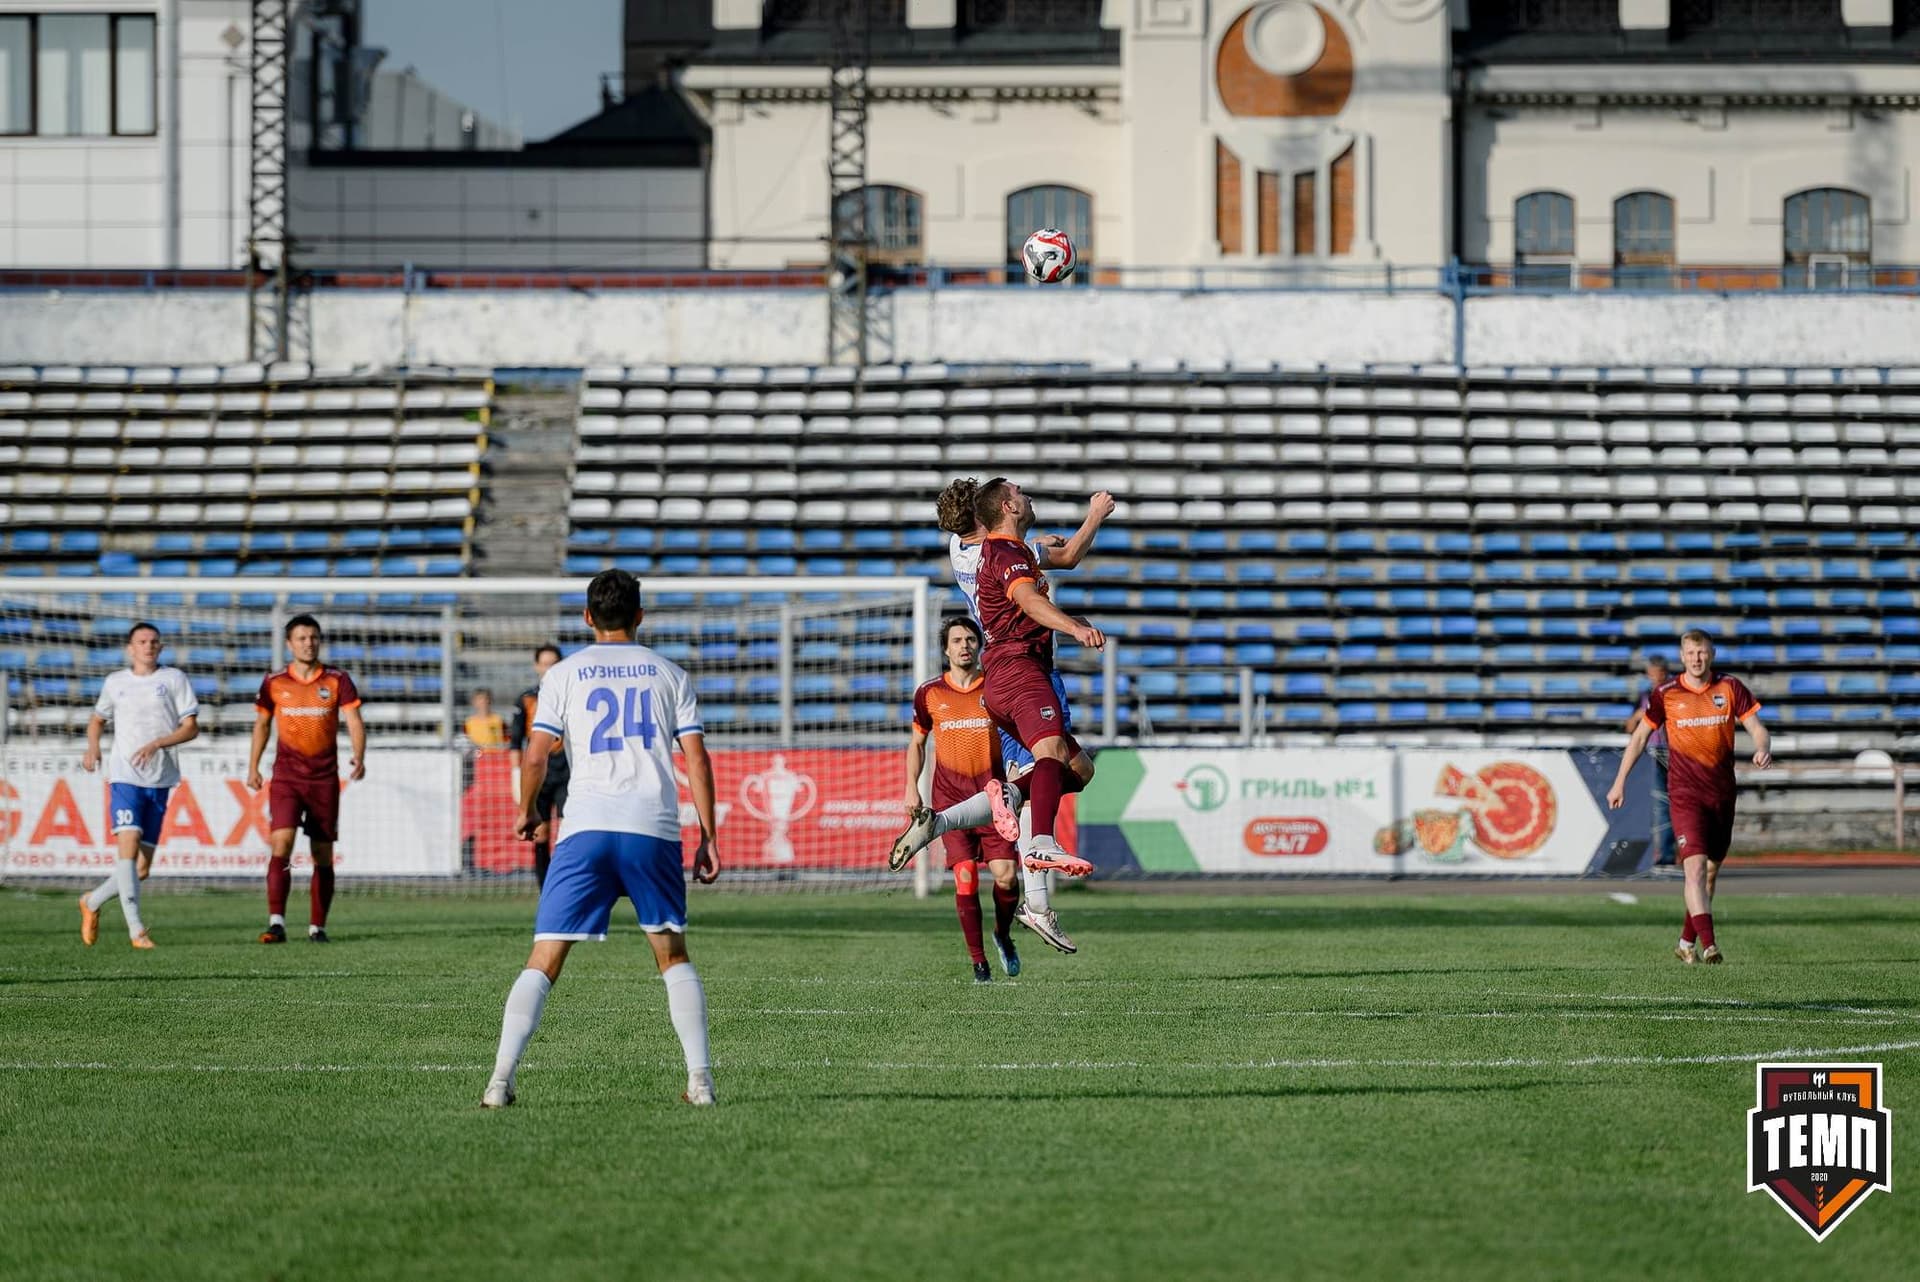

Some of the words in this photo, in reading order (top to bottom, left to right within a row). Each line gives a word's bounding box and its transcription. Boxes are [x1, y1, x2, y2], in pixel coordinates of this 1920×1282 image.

[578, 664, 657, 681] КУЗНЕЦОВ
[586, 687, 657, 754] 24
[1241, 778, 1327, 798] ГРИЛЬ
[116, 810, 133, 825] 30
[1263, 834, 1311, 854] 24/7
